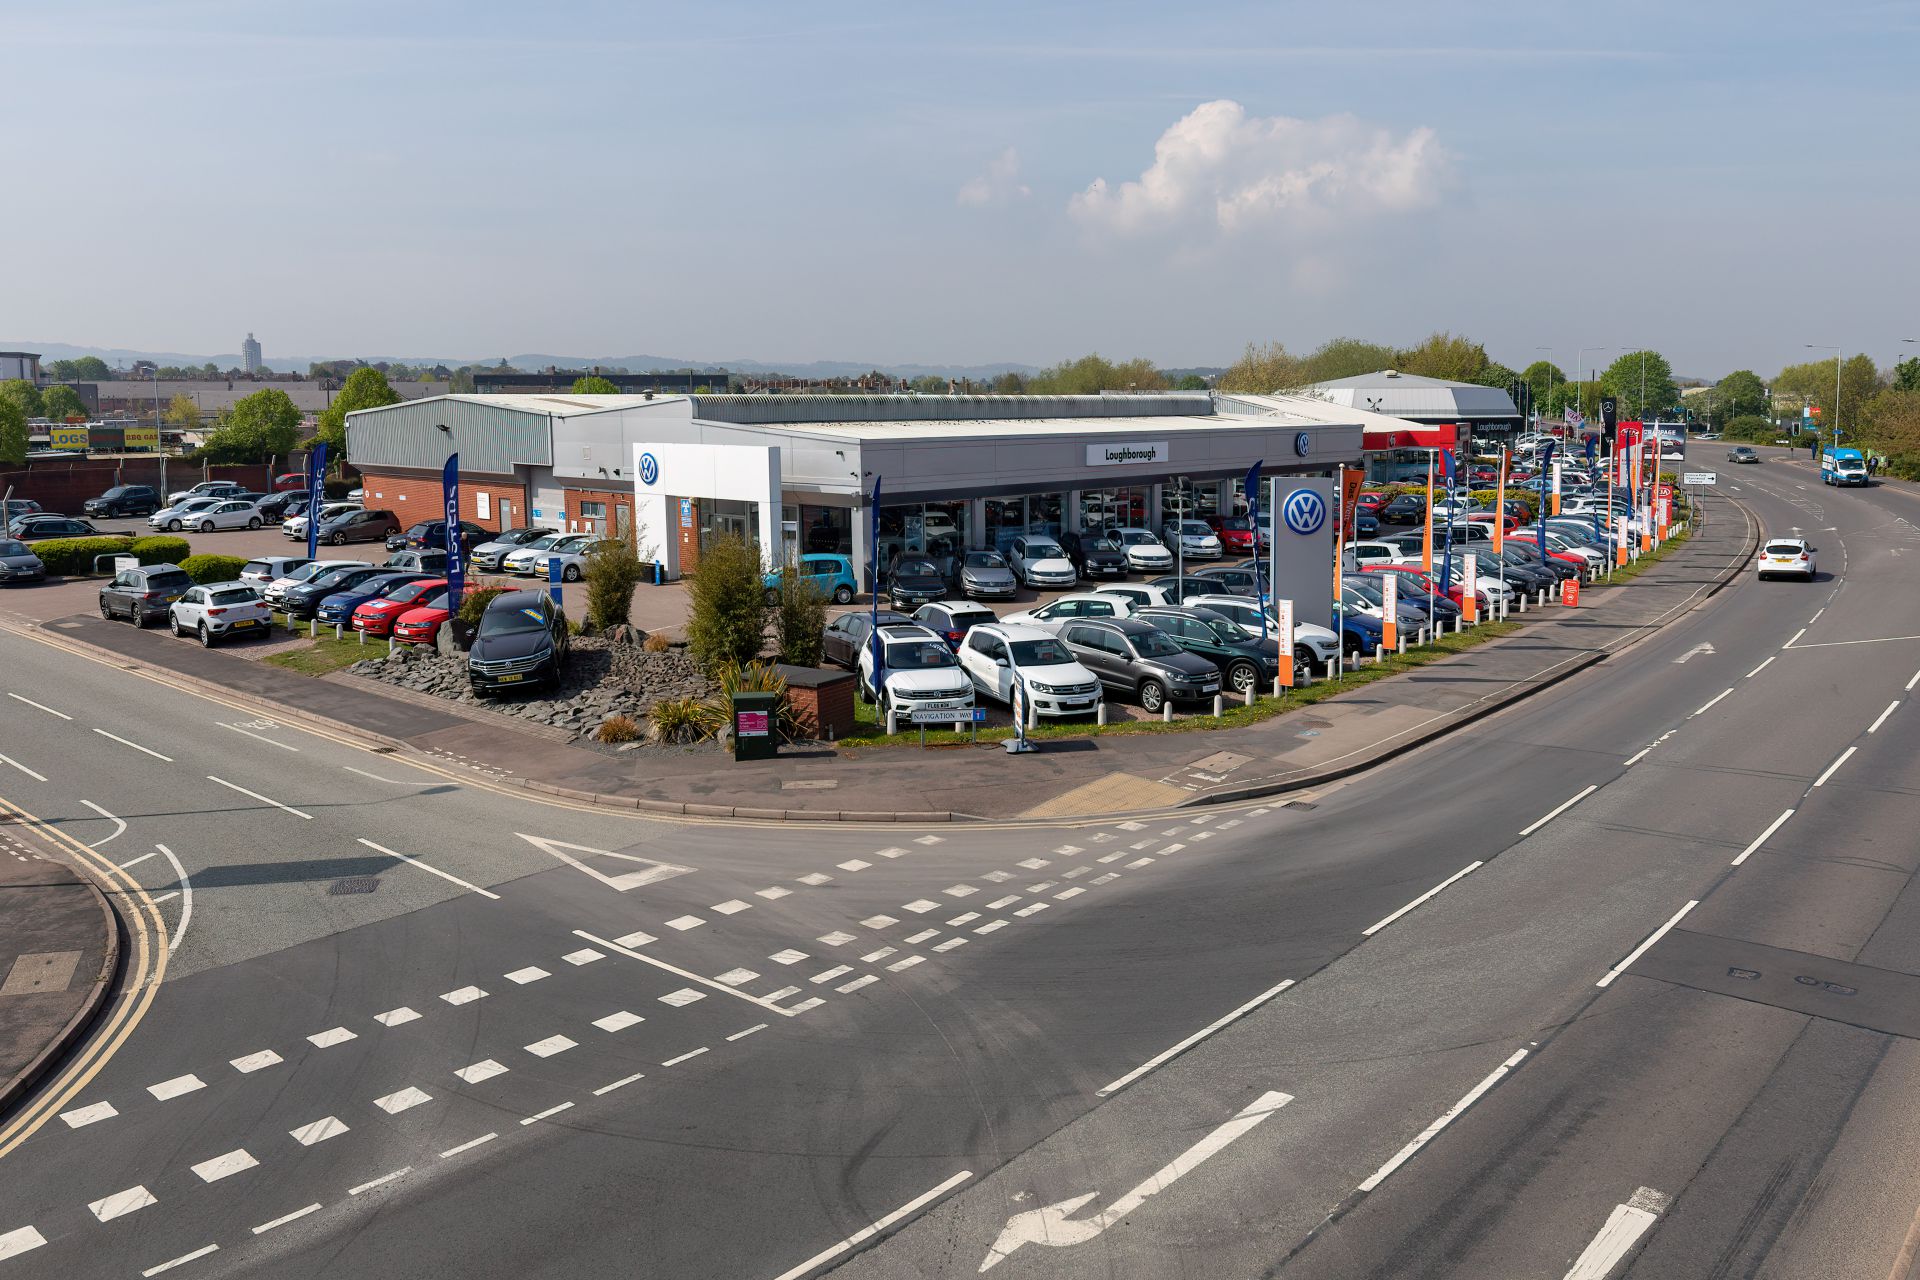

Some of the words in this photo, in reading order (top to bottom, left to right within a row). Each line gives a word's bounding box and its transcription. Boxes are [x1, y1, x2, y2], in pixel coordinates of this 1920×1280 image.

[1477, 422, 1512, 433] Loughborough
[52, 434, 88, 445] LOGS
[1105, 446, 1156, 463] Loughborough
[914, 711, 955, 720] NAVIGATION
[959, 711, 972, 719] WAY
